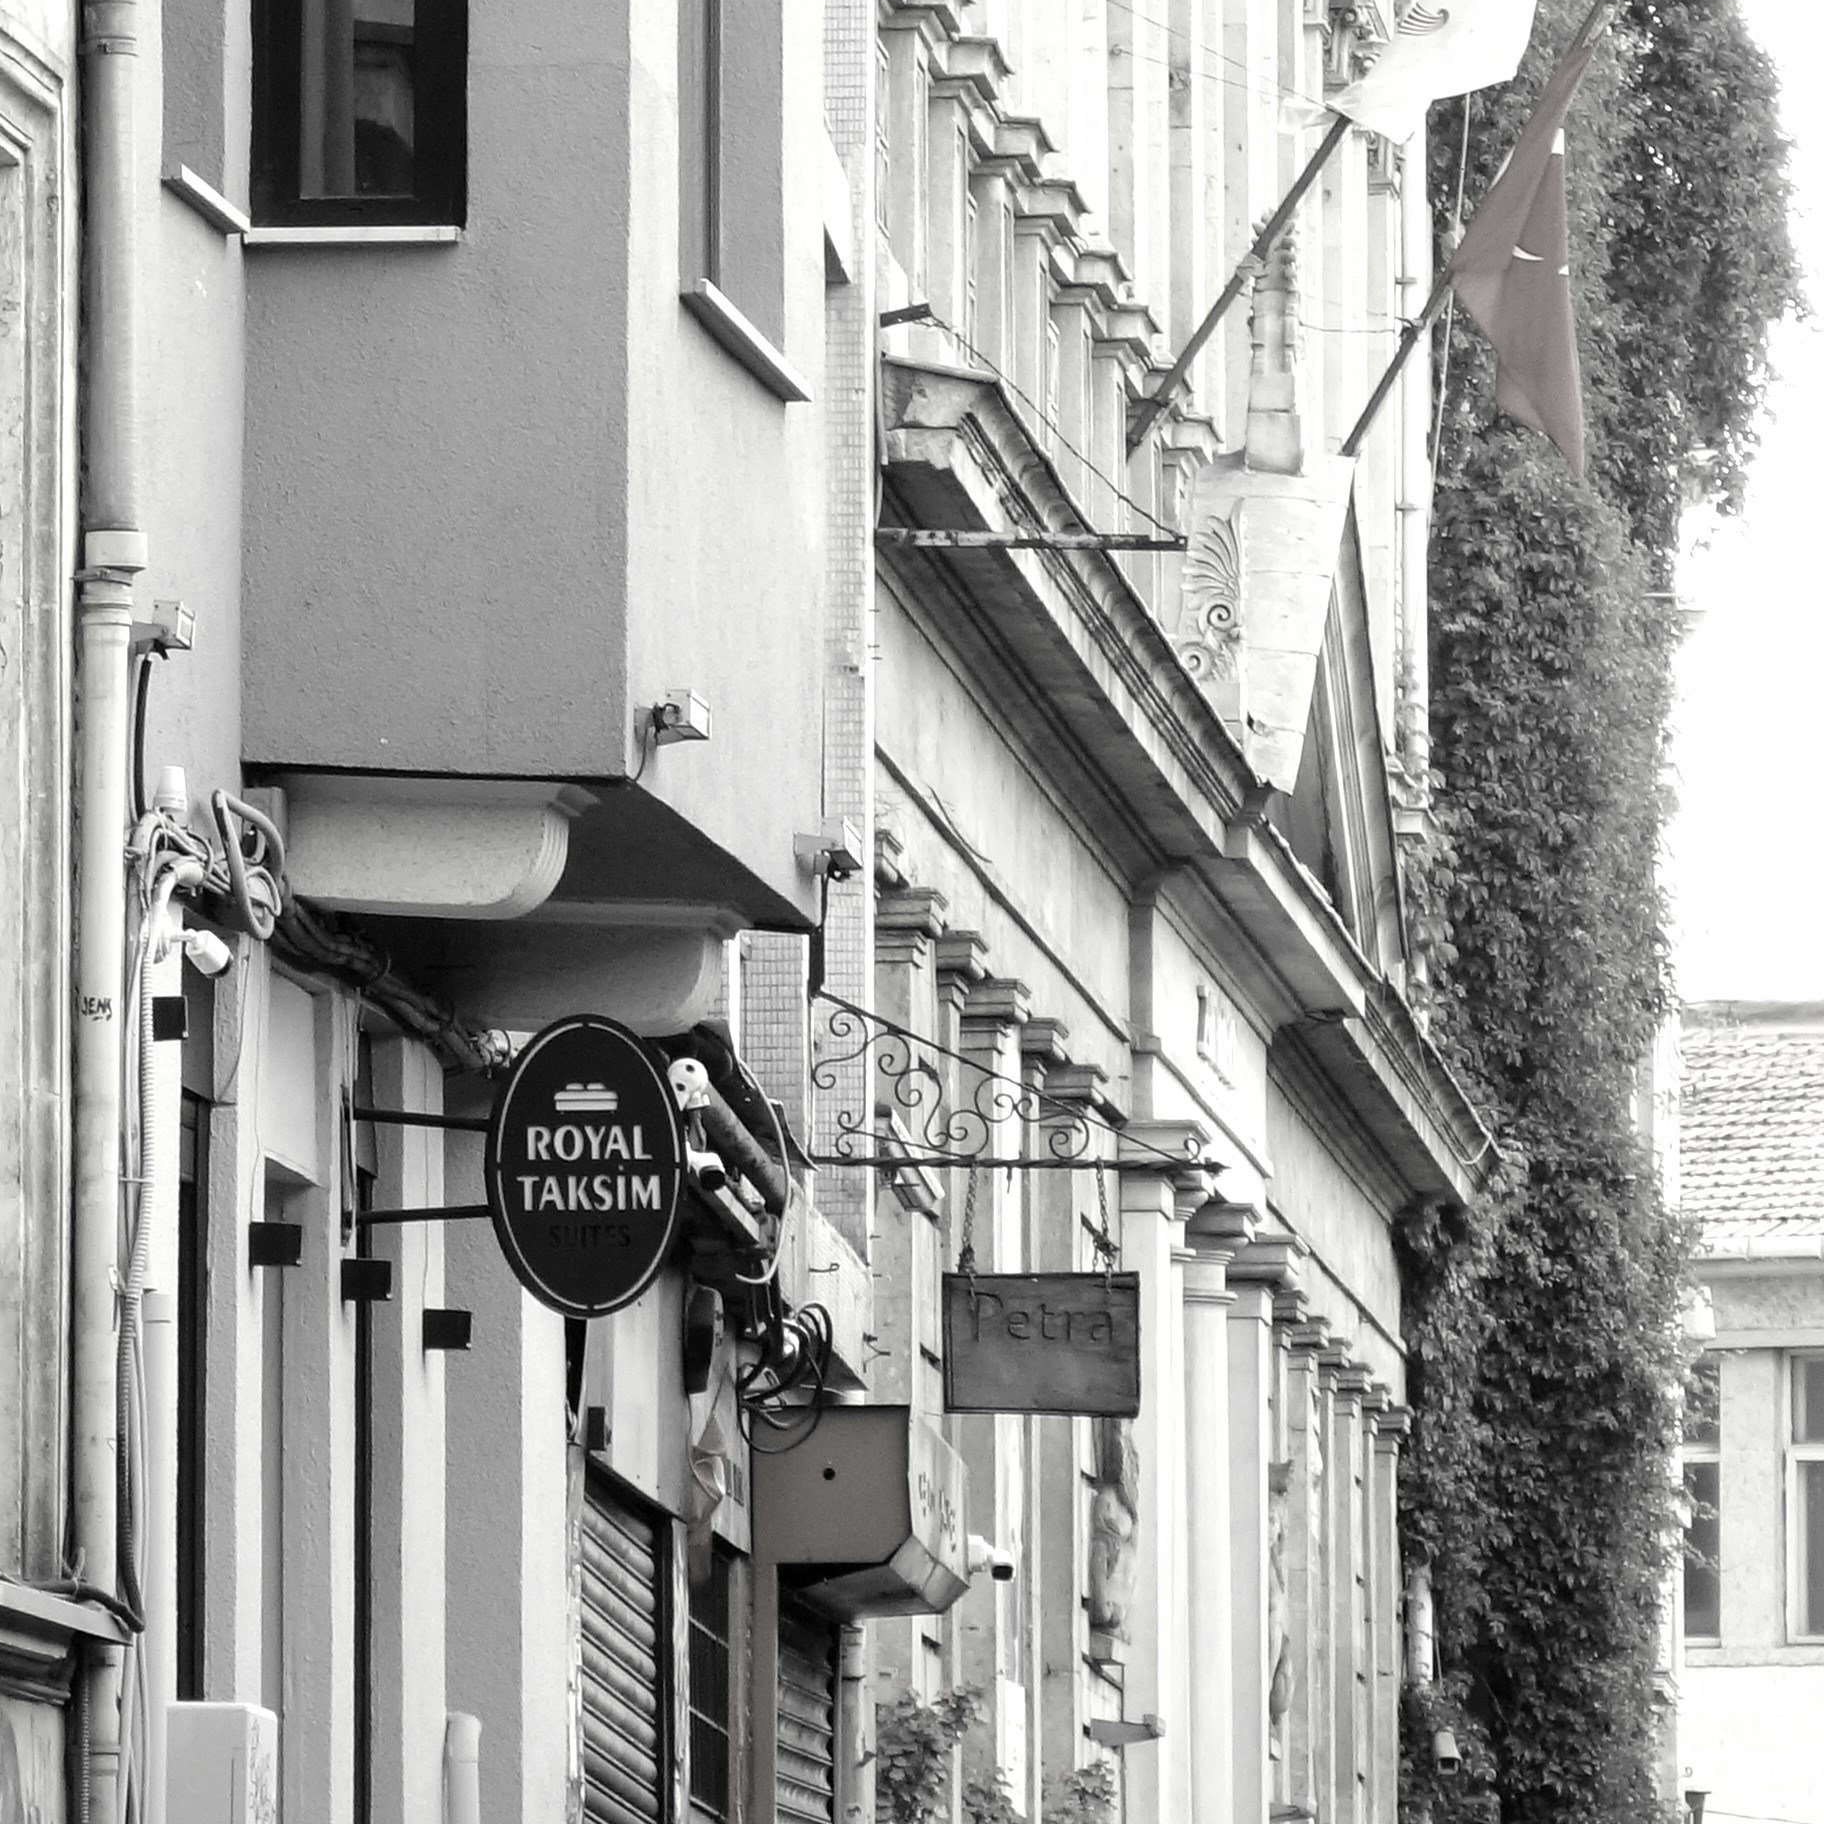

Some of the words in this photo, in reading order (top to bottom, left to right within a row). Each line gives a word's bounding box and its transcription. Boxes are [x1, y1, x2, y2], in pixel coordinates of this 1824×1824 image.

[526, 1124, 653, 1161] ROYAL
[517, 1165, 663, 1212] TAKSİM
[548, 1223, 632, 1248] SUITES
[968, 1288, 1113, 1343] Petra
